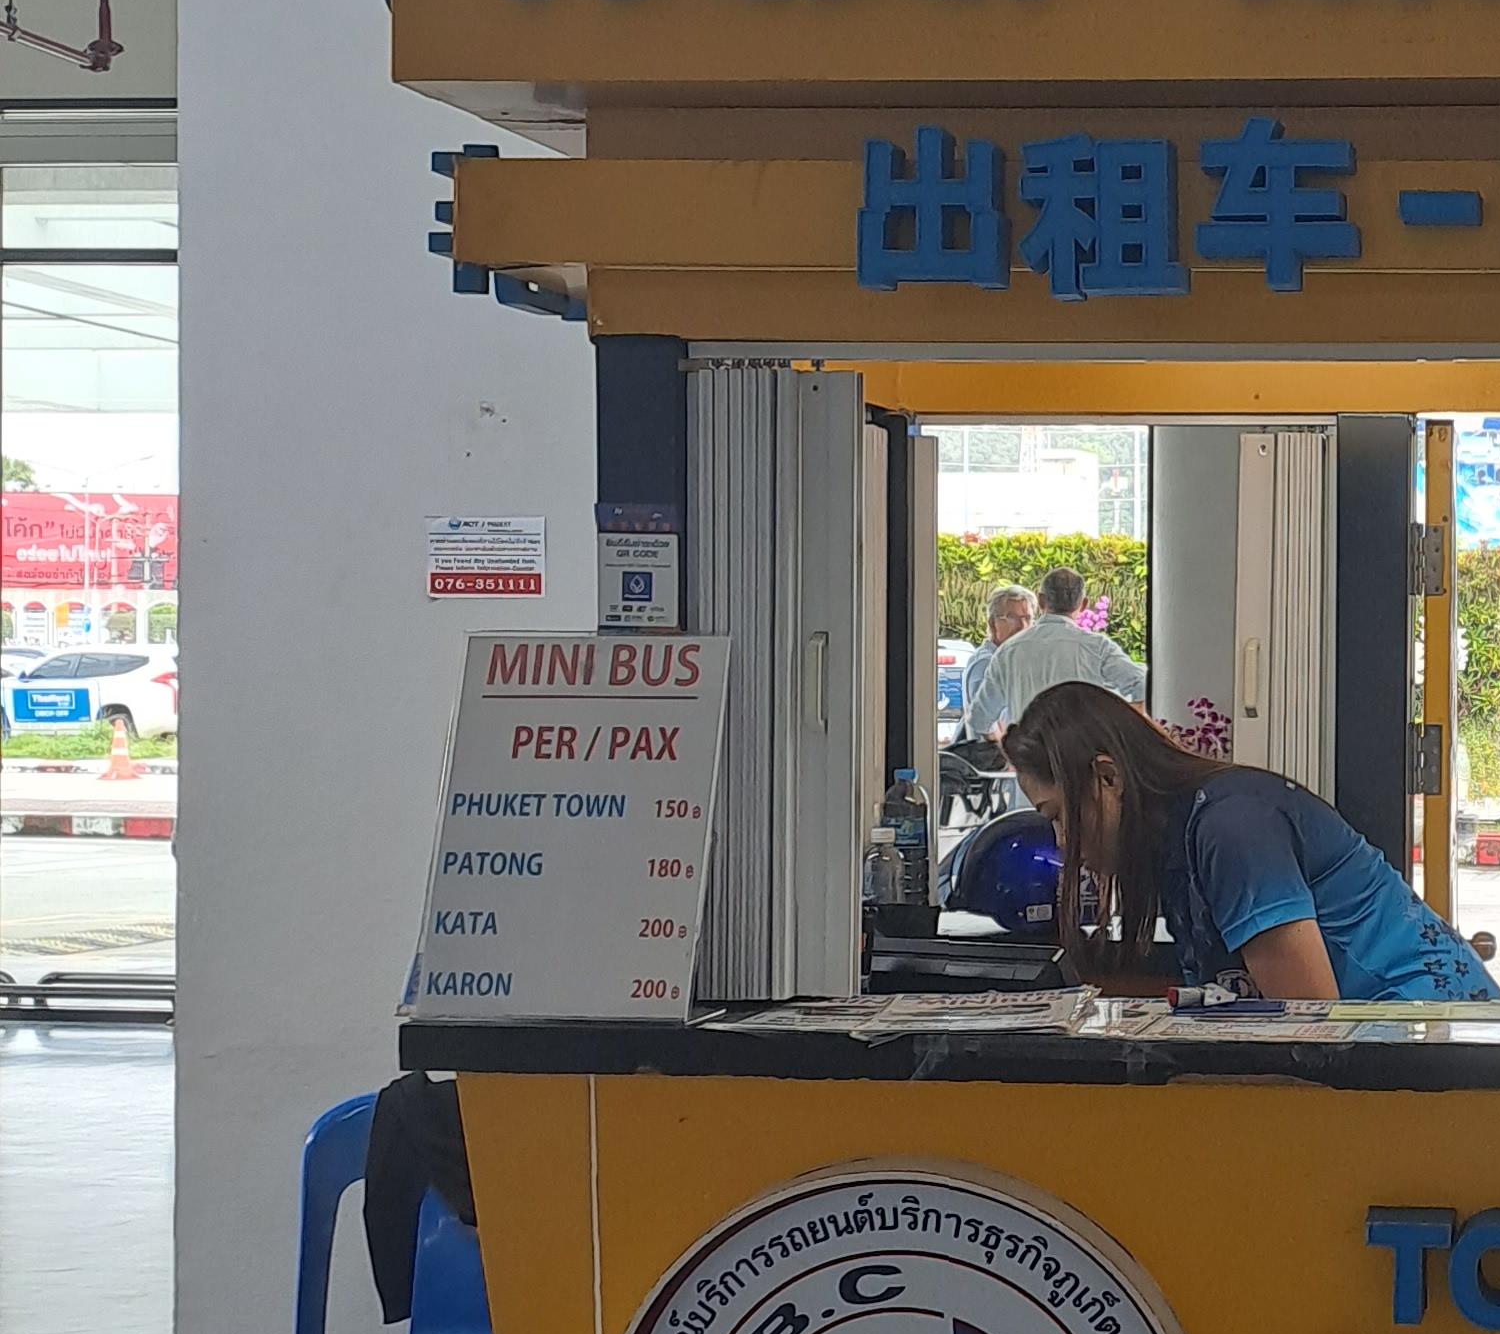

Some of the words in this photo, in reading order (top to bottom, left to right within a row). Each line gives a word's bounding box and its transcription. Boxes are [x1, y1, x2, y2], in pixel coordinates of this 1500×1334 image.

[486, 643, 597, 687] MINI
[608, 642, 701, 688] BUS
[511, 725, 576, 760] PER
[607, 727, 680, 762] PAX
[450, 793, 548, 818] PHUKET
[553, 794, 626, 818] TOWN
[654, 799, 689, 819] 150
[442, 851, 544, 877] PATONG
[647, 859, 682, 878] 180
[434, 911, 498, 936] KATA
[639, 918, 674, 939] 200
[426, 971, 513, 998] KARON
[630, 979, 667, 999] 200
